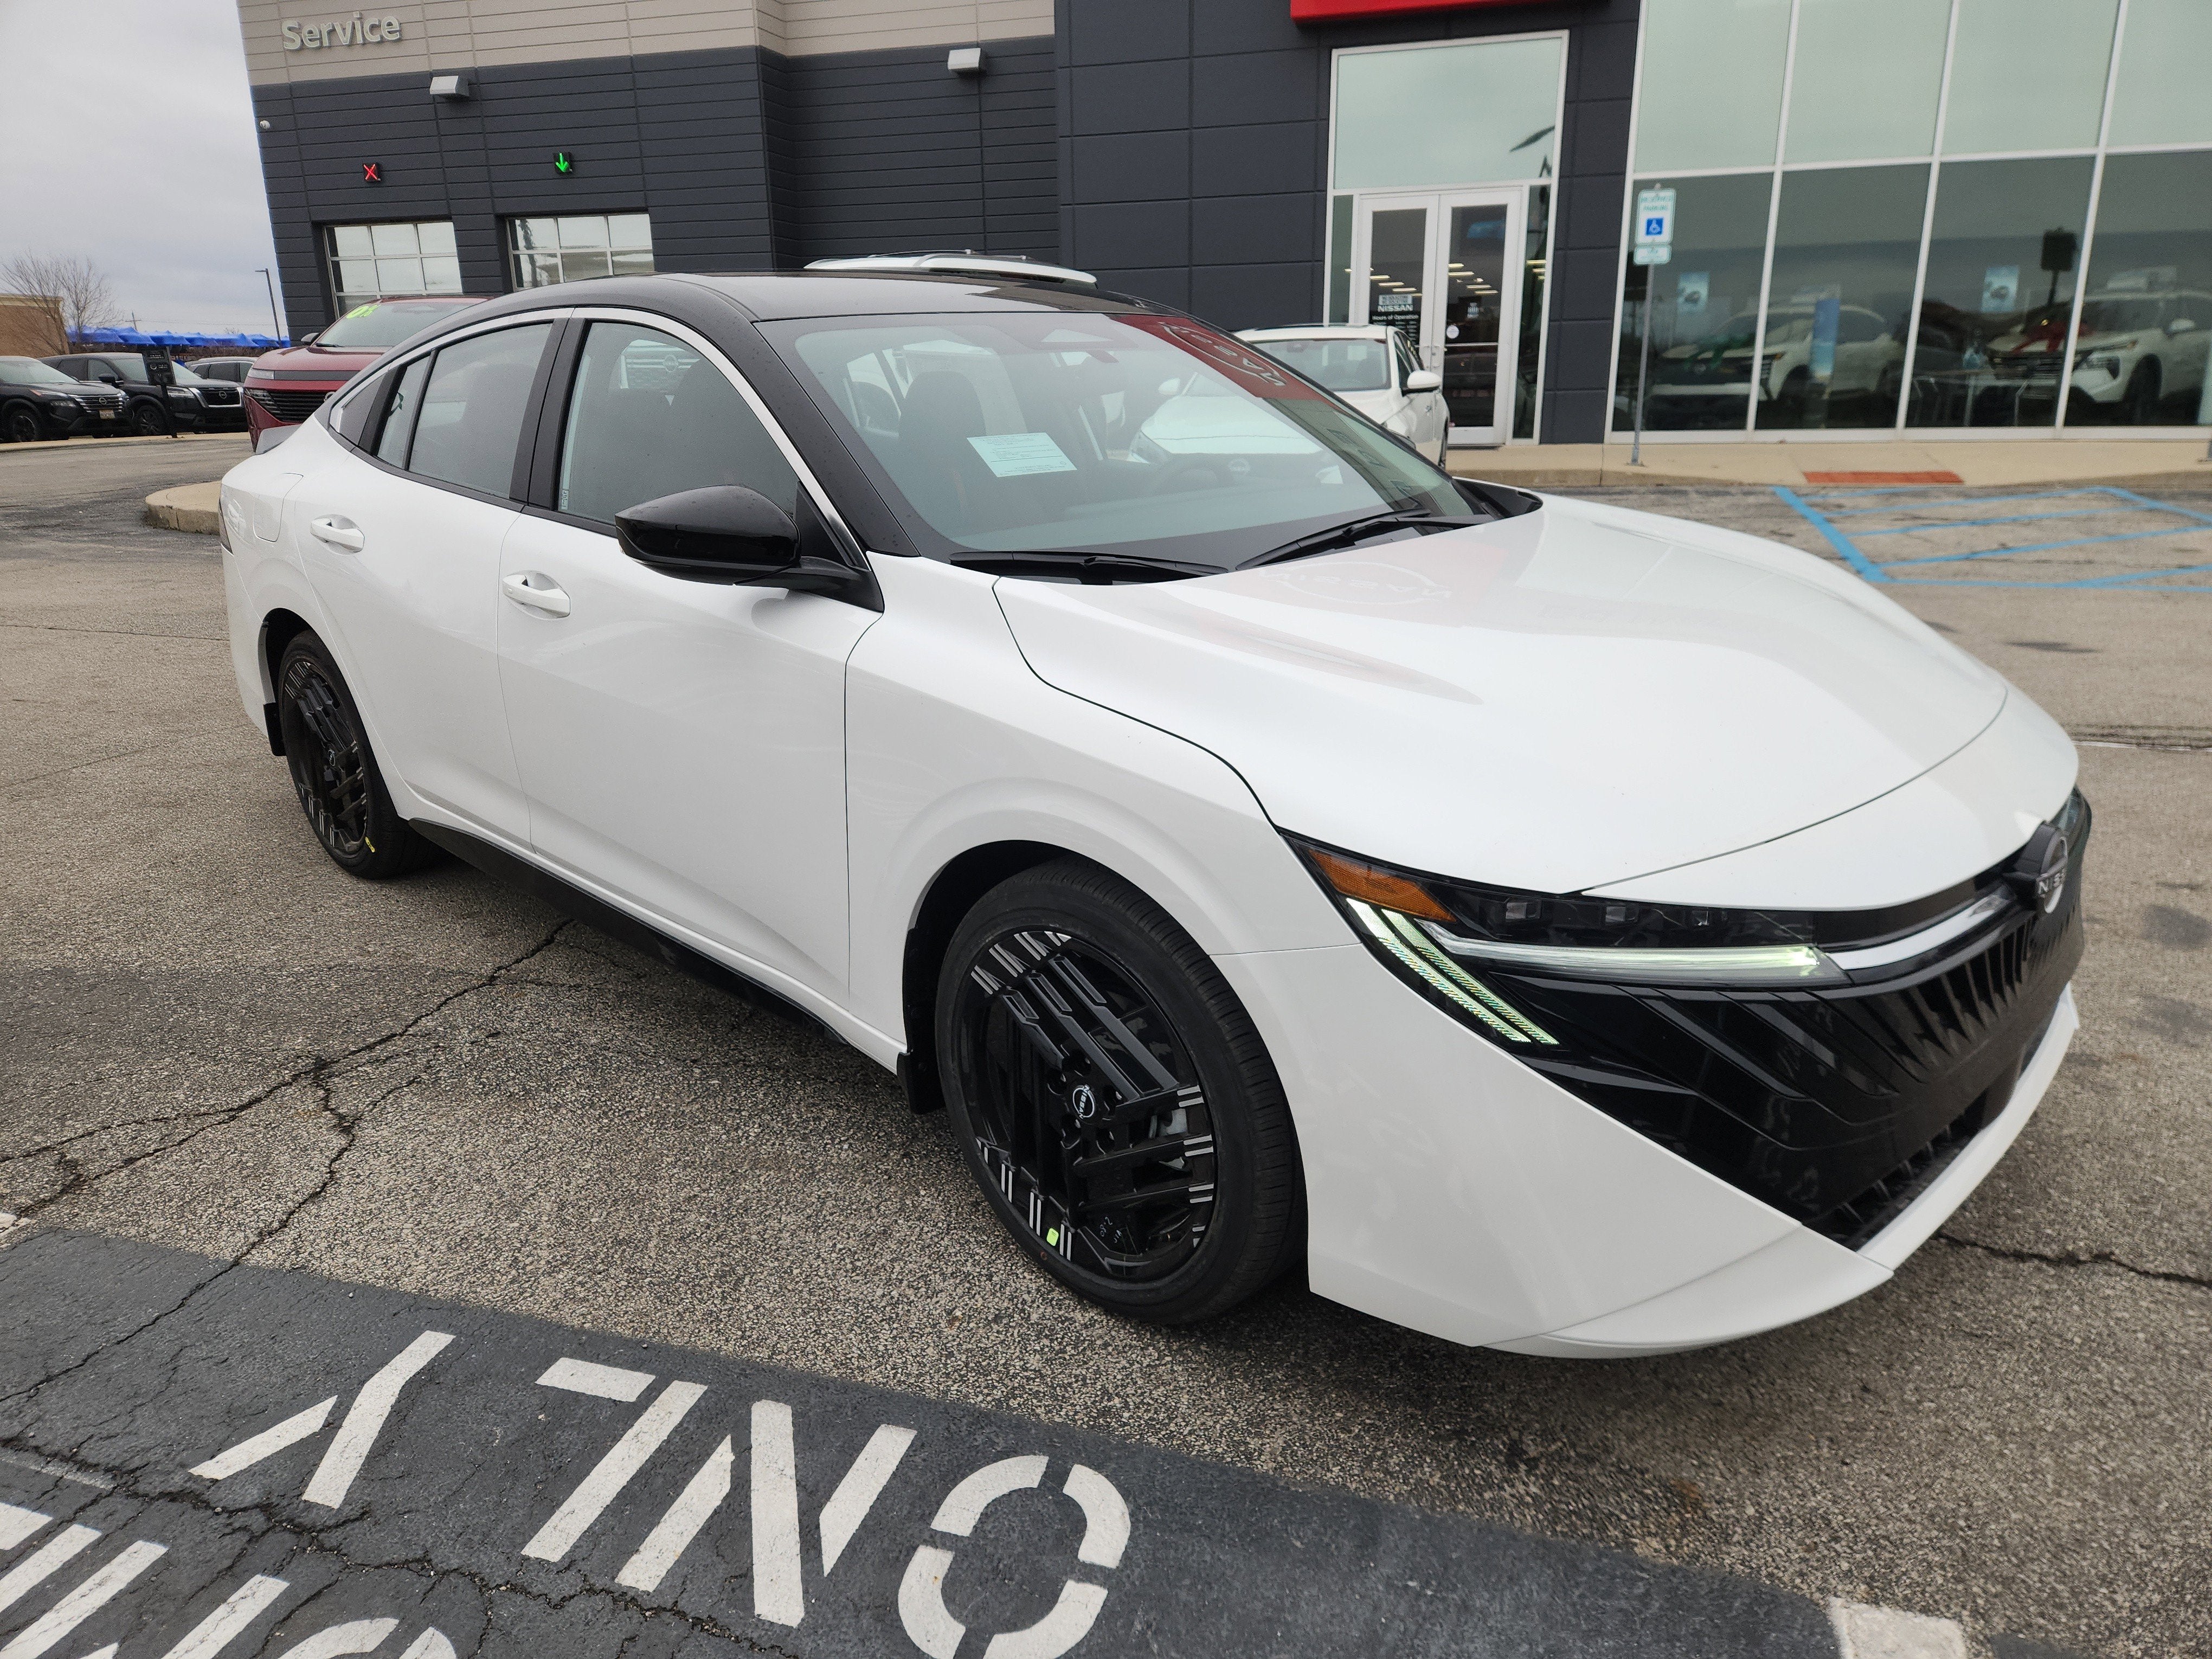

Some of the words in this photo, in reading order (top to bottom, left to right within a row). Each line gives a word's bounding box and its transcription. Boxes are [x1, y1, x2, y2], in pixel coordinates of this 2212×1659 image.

[281, 11, 401, 50] Service
[1078, 1084, 1090, 1120] NISSAN
[189, 1329, 1131, 1659] ONLY
